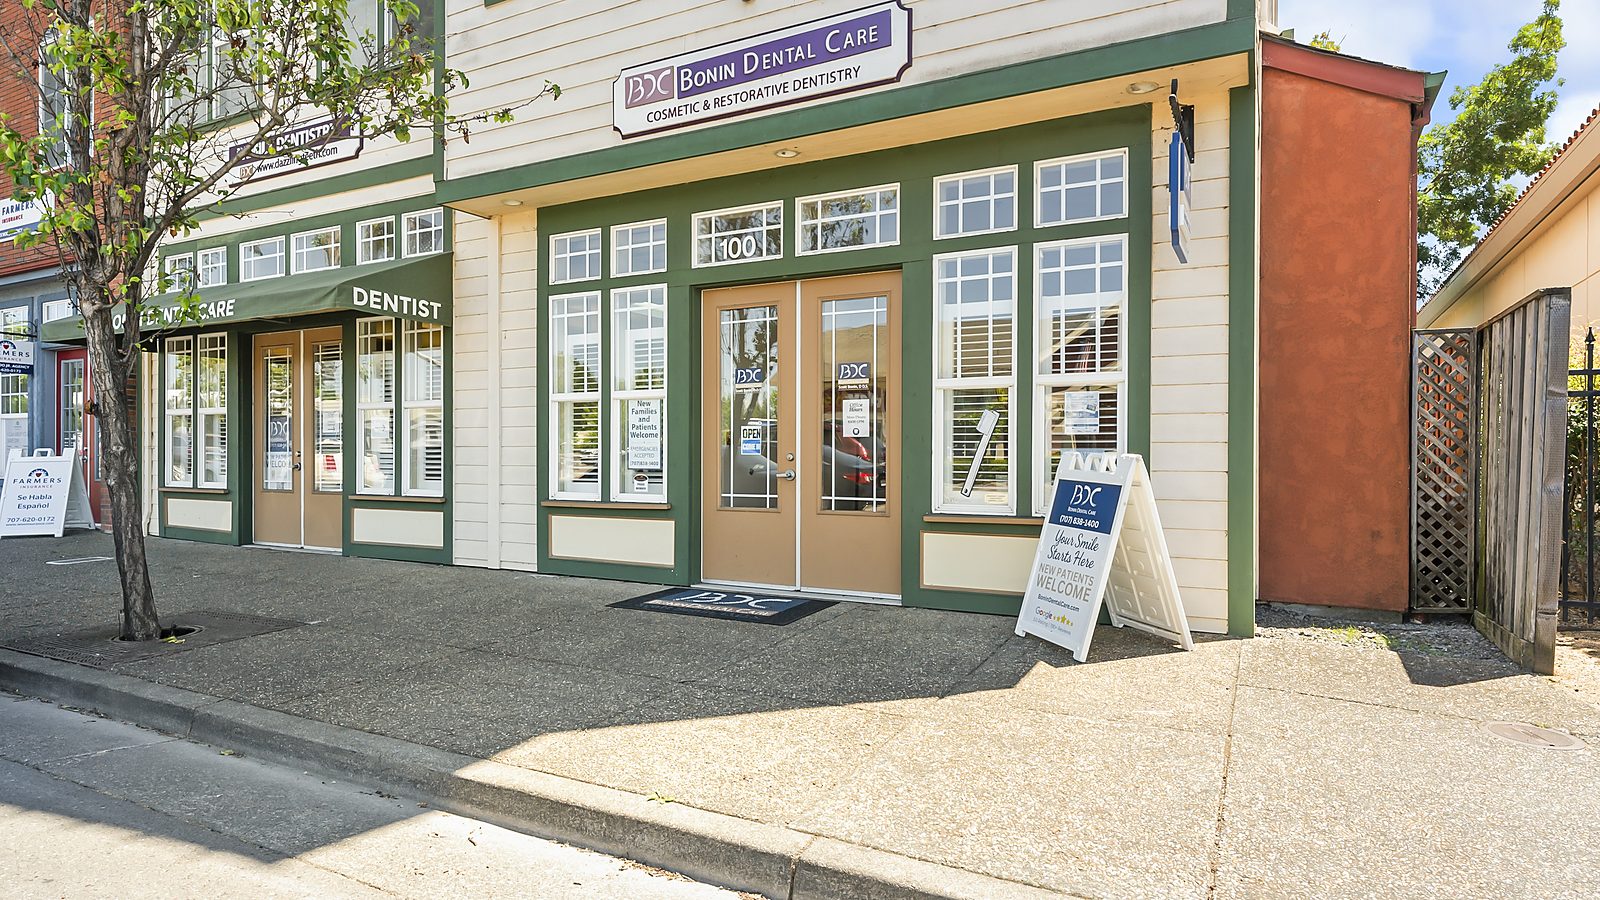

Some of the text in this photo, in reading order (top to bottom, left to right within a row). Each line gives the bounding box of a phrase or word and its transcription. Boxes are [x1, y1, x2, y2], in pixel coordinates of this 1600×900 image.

[680, 62, 735, 92] BONIN
[743, 43, 816, 73] DENTAL
[825, 25, 879, 53] CARE
[646, 65, 861, 123] COSMETIC & RESTORATIVE DENTISTRY
[719, 235, 756, 259] 100
[199, 299, 236, 320] CARE
[353, 286, 442, 320] DENTIST
[742, 428, 761, 439] OPEN
[17, 502, 50, 510] Español
[1060, 514, 1073, 525] (707)
[1055, 529, 1100, 551] Your Smile
[1047, 544, 1095, 569] Starts Here
[1038, 562, 1095, 586] NEW PATIENTS
[1036, 573, 1092, 603] WELCOME
